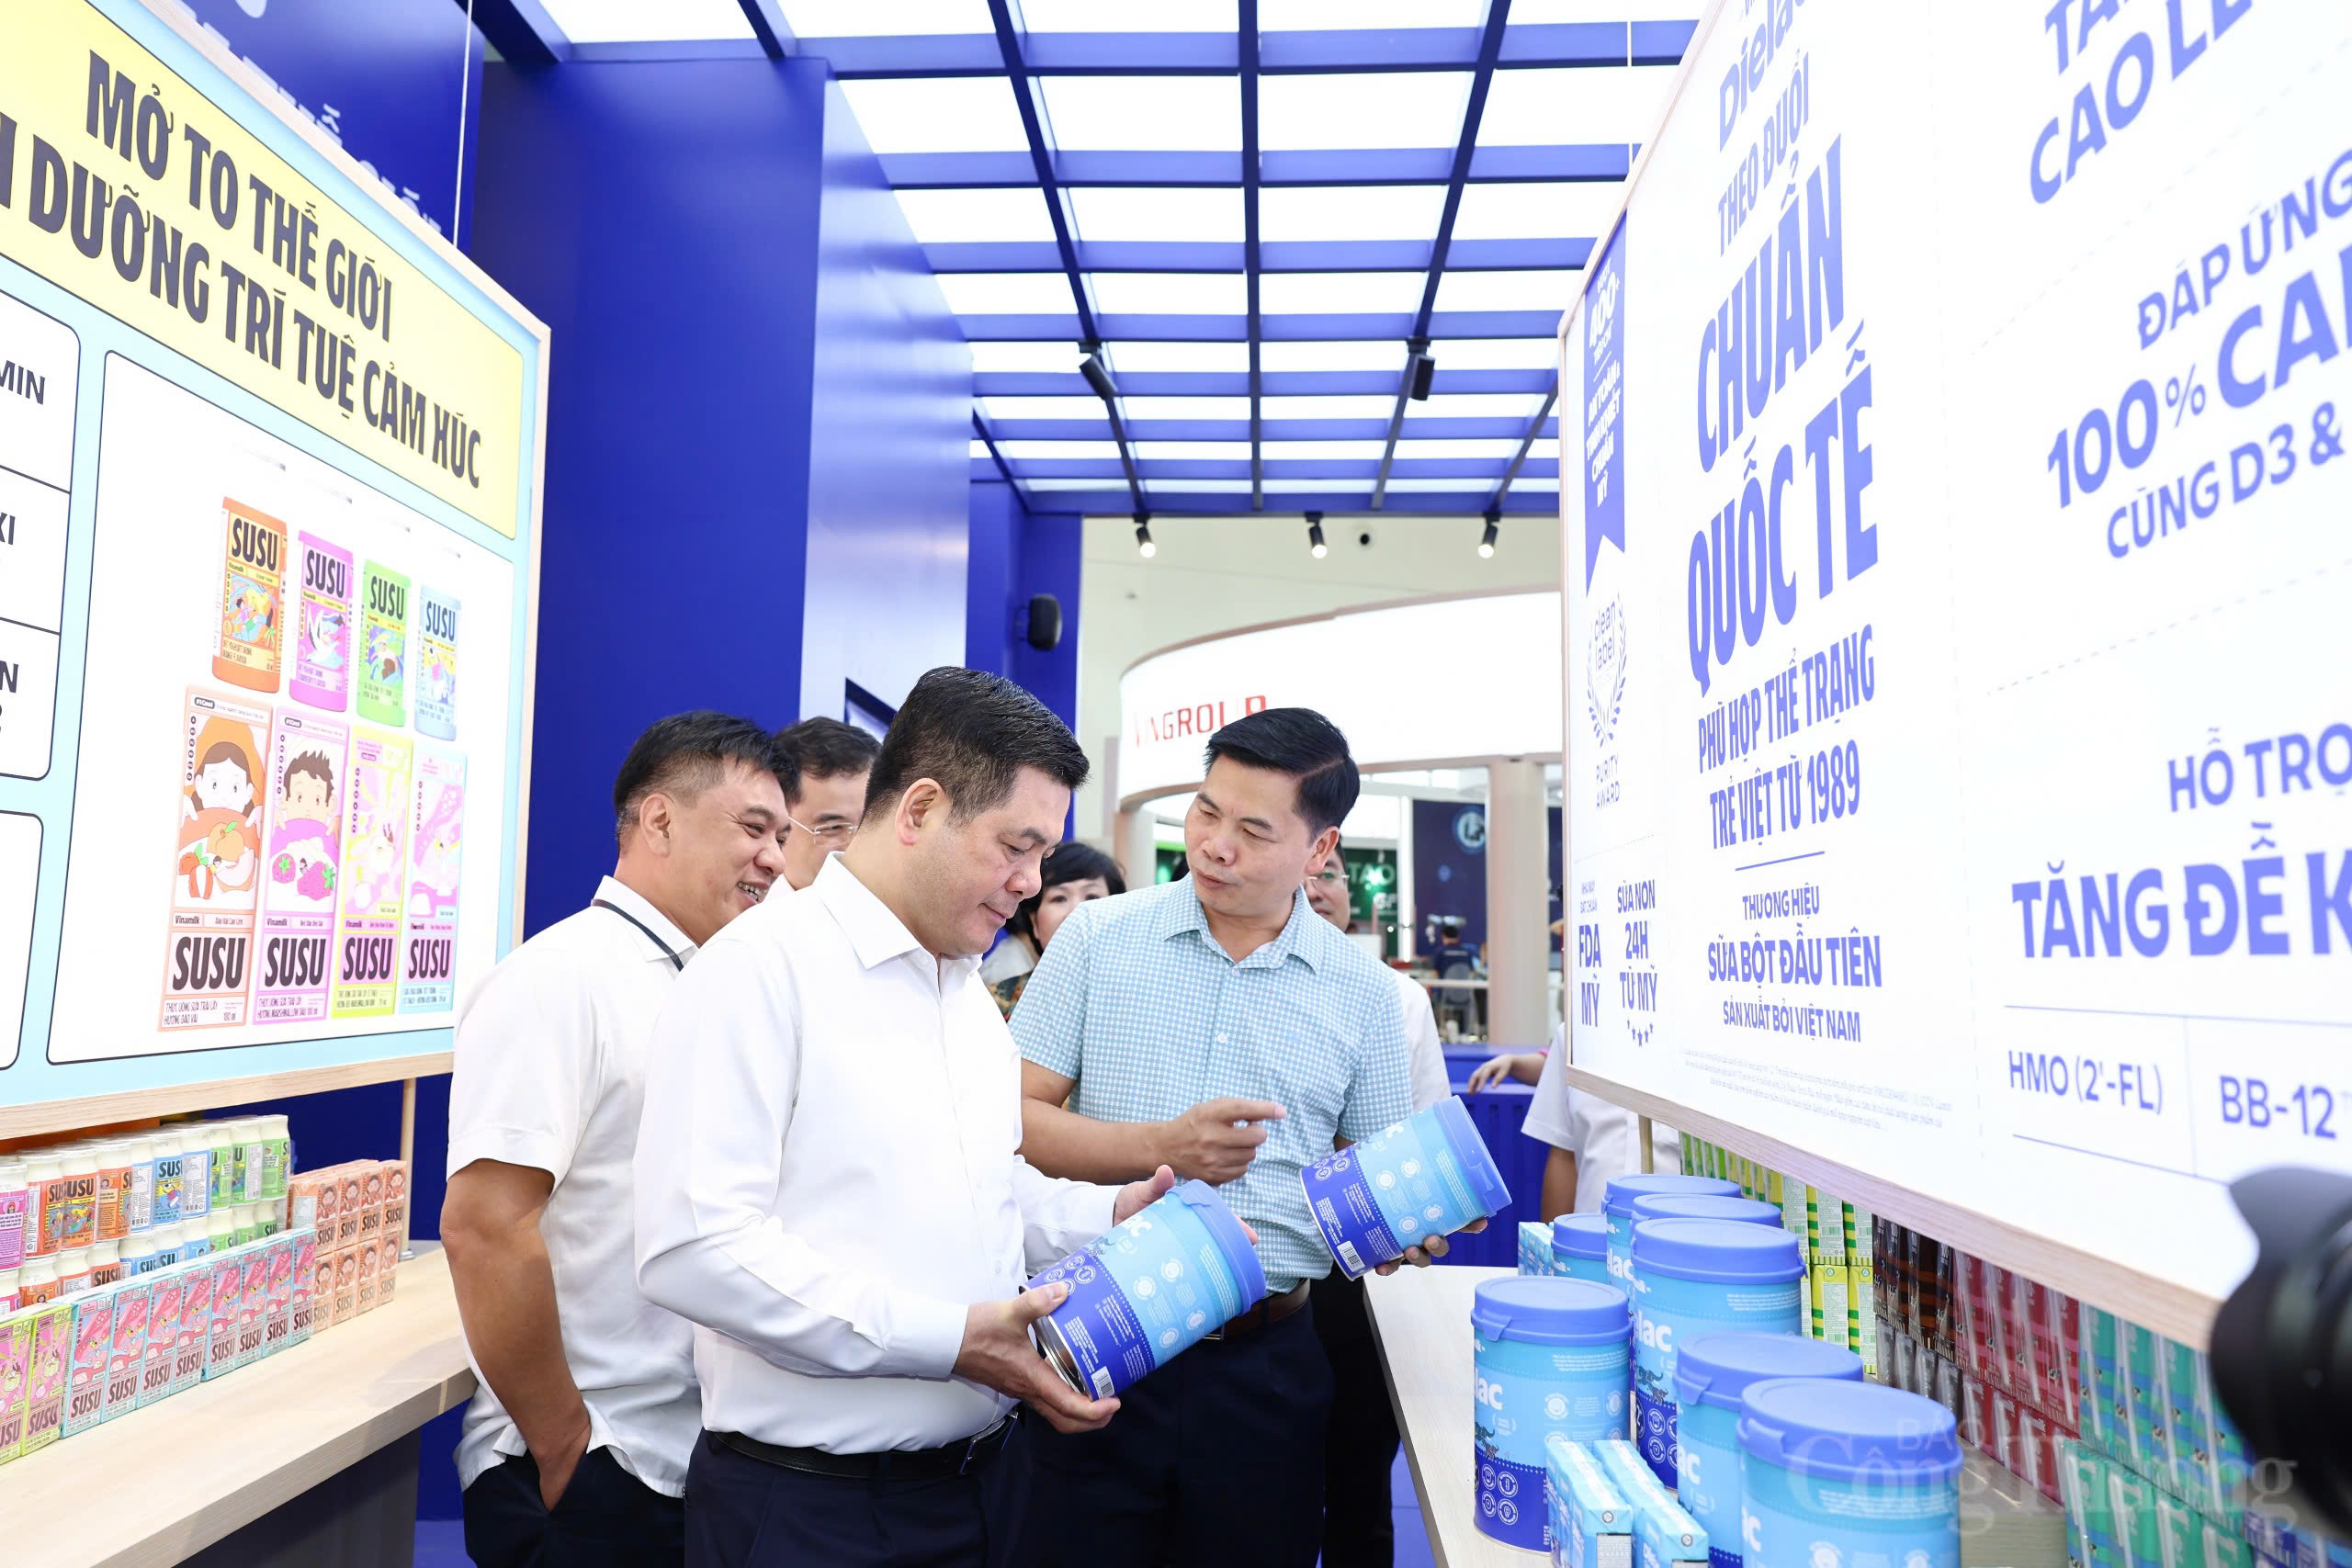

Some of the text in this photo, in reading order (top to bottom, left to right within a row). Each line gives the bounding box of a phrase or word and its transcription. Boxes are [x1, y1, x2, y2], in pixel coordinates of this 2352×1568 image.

[2030, 31, 2154, 204] CAO
[1718, 48, 1809, 257] THEO ĐUỔI
[86, 49, 174, 181] MỞ
[185, 123, 239, 231] TO
[249, 173, 319, 292] THẾ
[325, 238, 392, 343] GIỚI
[28, 133, 209, 323] DƯỠNG
[220, 260, 287, 370] TRÍ
[293, 310, 356, 419] TUỆ
[362, 359, 427, 457] CẢM
[431, 402, 481, 489] XÚC
[1697, 133, 1844, 473] CHUẨN
[2137, 255, 2231, 351] ĐÁP
[2047, 364, 2206, 509] 100%
[2230, 423, 2297, 504] D3
[2310, 401, 2346, 466] &
[1688, 318, 1878, 698] QUỐC TẾ
[232, 518, 278, 571] SUSU
[306, 549, 345, 599] SUSU
[369, 575, 405, 621] SUSU
[425, 601, 456, 642] SUSU
[1699, 624, 1874, 773] PHÙ HỢP THỂ TRẠNG
[2168, 727, 2233, 812] HỖ
[1710, 739, 1860, 849] TRẺ VIỆT TỪ 1989
[1634, 879, 1656, 910] NON
[1743, 882, 1820, 920] THƯƠNG HIỆU
[2012, 861, 2170, 958] TĂNG
[172, 936, 246, 990] SUSU
[265, 937, 326, 987] SUSU
[343, 937, 393, 981] SUSU
[408, 939, 451, 979] SUSU
[1578, 923, 1601, 967] FDA
[1625, 920, 1648, 959] 24H
[1708, 922, 1883, 988] SỮA BỘT ĐẦU TIÊN
[1581, 974, 1600, 1027] MỸ
[1620, 964, 1657, 1012] TỪ MỸ
[1723, 994, 1861, 1043] SẢN XUẤT BỞI VIỆT NAM
[2008, 1050, 2069, 1096] HMO
[362, 1209, 380, 1231] SUSU
[385, 1204, 402, 1224] SUSU
[211, 1337, 236, 1363] SUSU
[240, 1328, 262, 1352] SUSU
[267, 1317, 288, 1341] SUSU
[143, 1362, 171, 1390] SUSU
[176, 1350, 203, 1377] SUSU
[71, 1388, 102, 1417] SUSU
[108, 1376, 138, 1404] SUSU
[28, 1404, 59, 1436] SUSU
